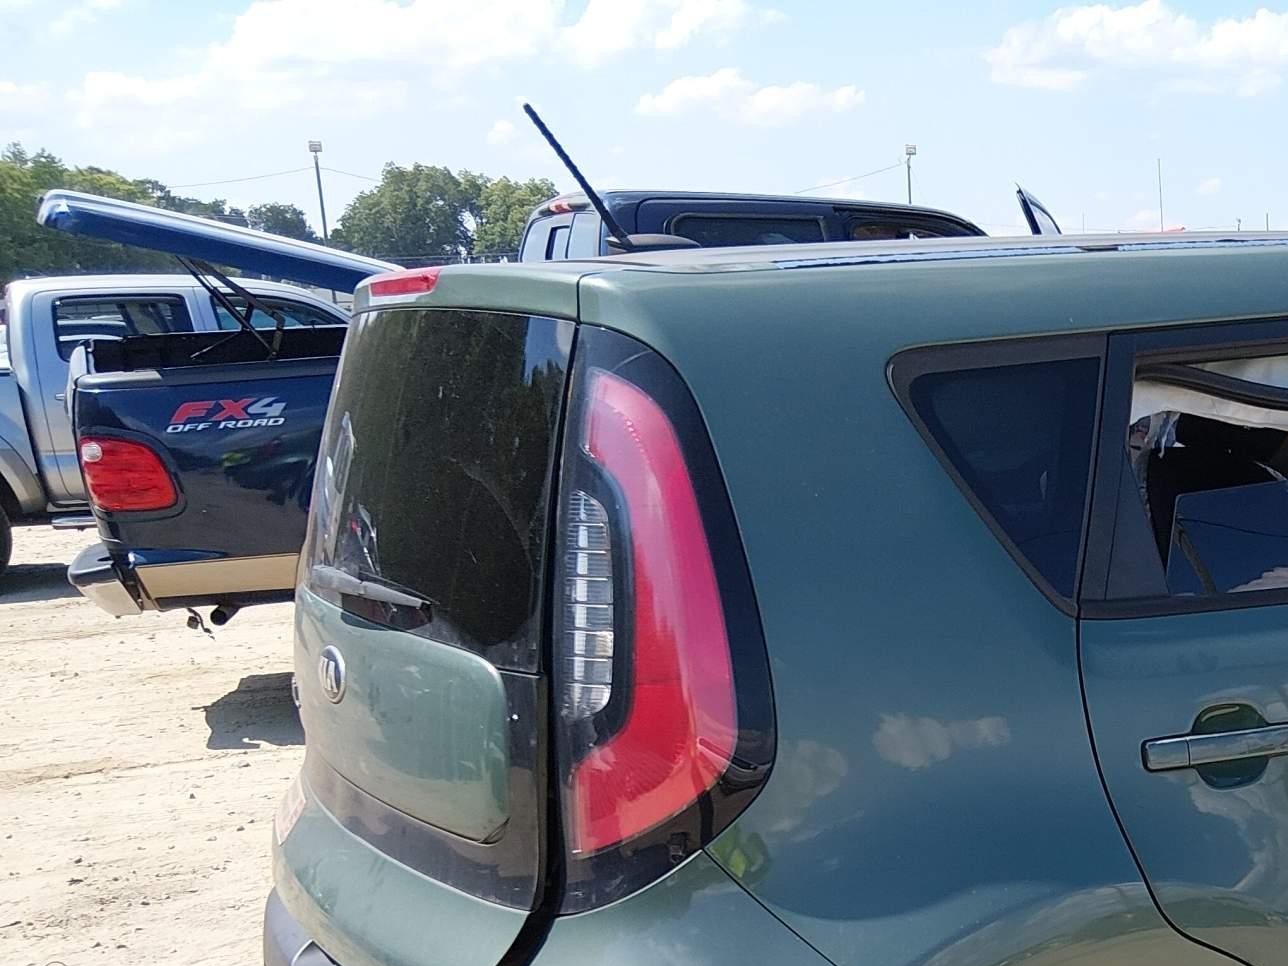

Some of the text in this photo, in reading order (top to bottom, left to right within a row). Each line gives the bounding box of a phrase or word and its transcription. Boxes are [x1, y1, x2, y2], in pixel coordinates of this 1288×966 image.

[169, 396, 287, 424] FX4
[166, 417, 286, 433] OFF ROAD
